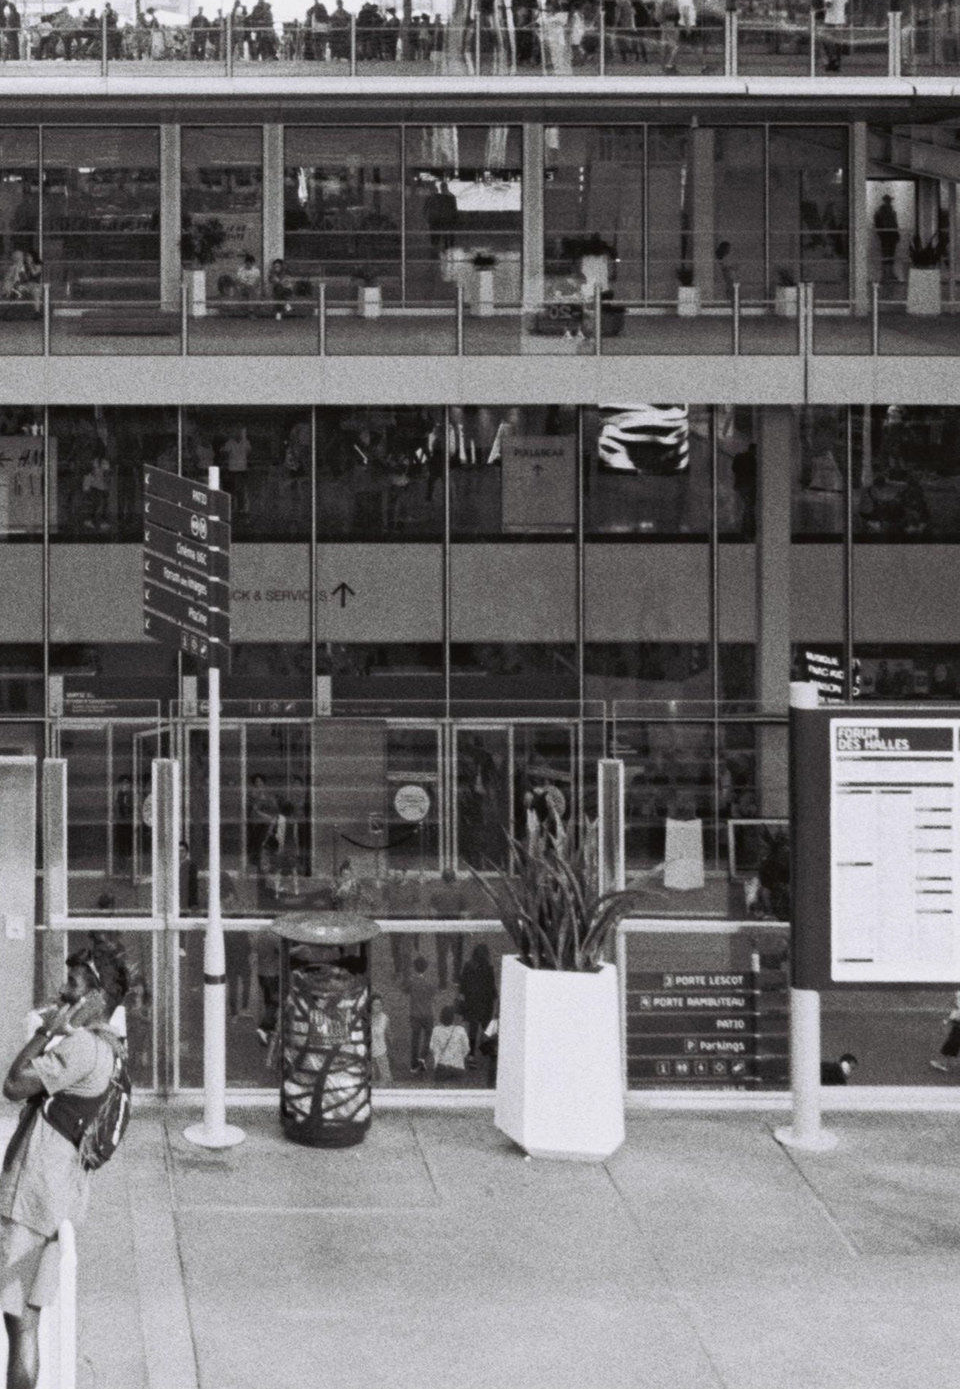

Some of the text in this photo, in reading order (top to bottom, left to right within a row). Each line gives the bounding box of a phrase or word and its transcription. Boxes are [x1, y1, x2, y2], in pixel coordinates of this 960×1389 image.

[265, 591, 328, 602] SERVICS
[838, 727, 880, 739] FORUM
[839, 739, 910, 750] DES HALLES
[675, 975, 706, 986] PORTE
[709, 975, 744, 986] LESCOT
[653, 997, 683, 1007] PORTE
[687, 997, 745, 1007] RAMBUTEAU
[716, 1019, 745, 1029] PATIO
[700, 1040, 745, 1052] Parkings
